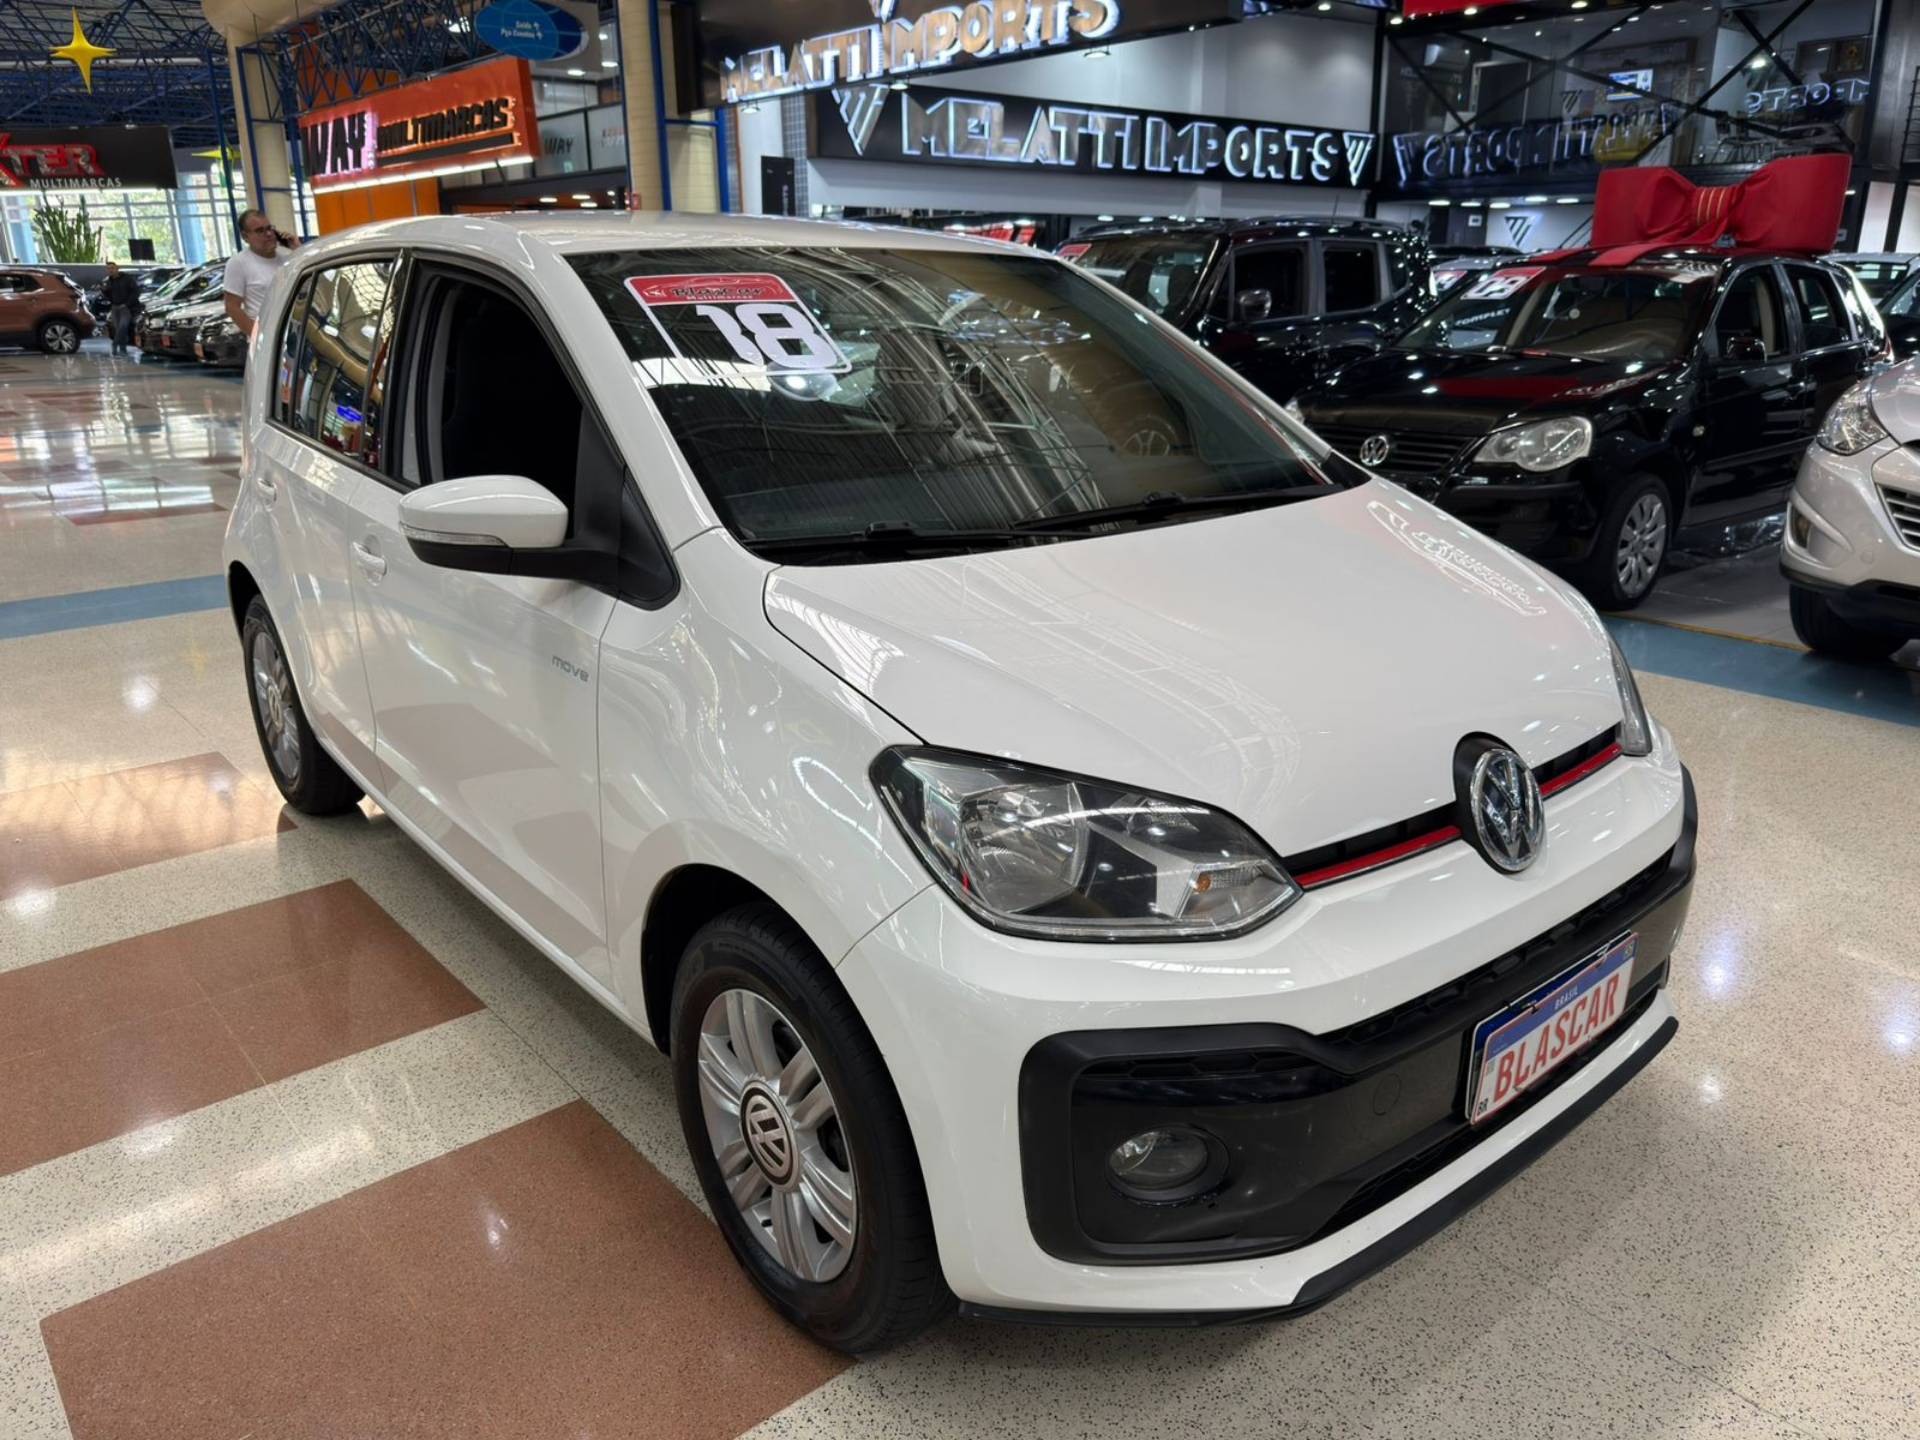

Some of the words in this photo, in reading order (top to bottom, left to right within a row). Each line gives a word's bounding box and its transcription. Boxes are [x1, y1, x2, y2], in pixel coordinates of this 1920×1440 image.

[302, 110, 376, 176] WAY
[377, 97, 517, 153] MULTIMARCAS
[30, 177, 122, 189] MULTIMARCAS
[695, 303, 839, 370] 18
[551, 655, 590, 682] move
[1493, 971, 1620, 1104] BLASCAR
